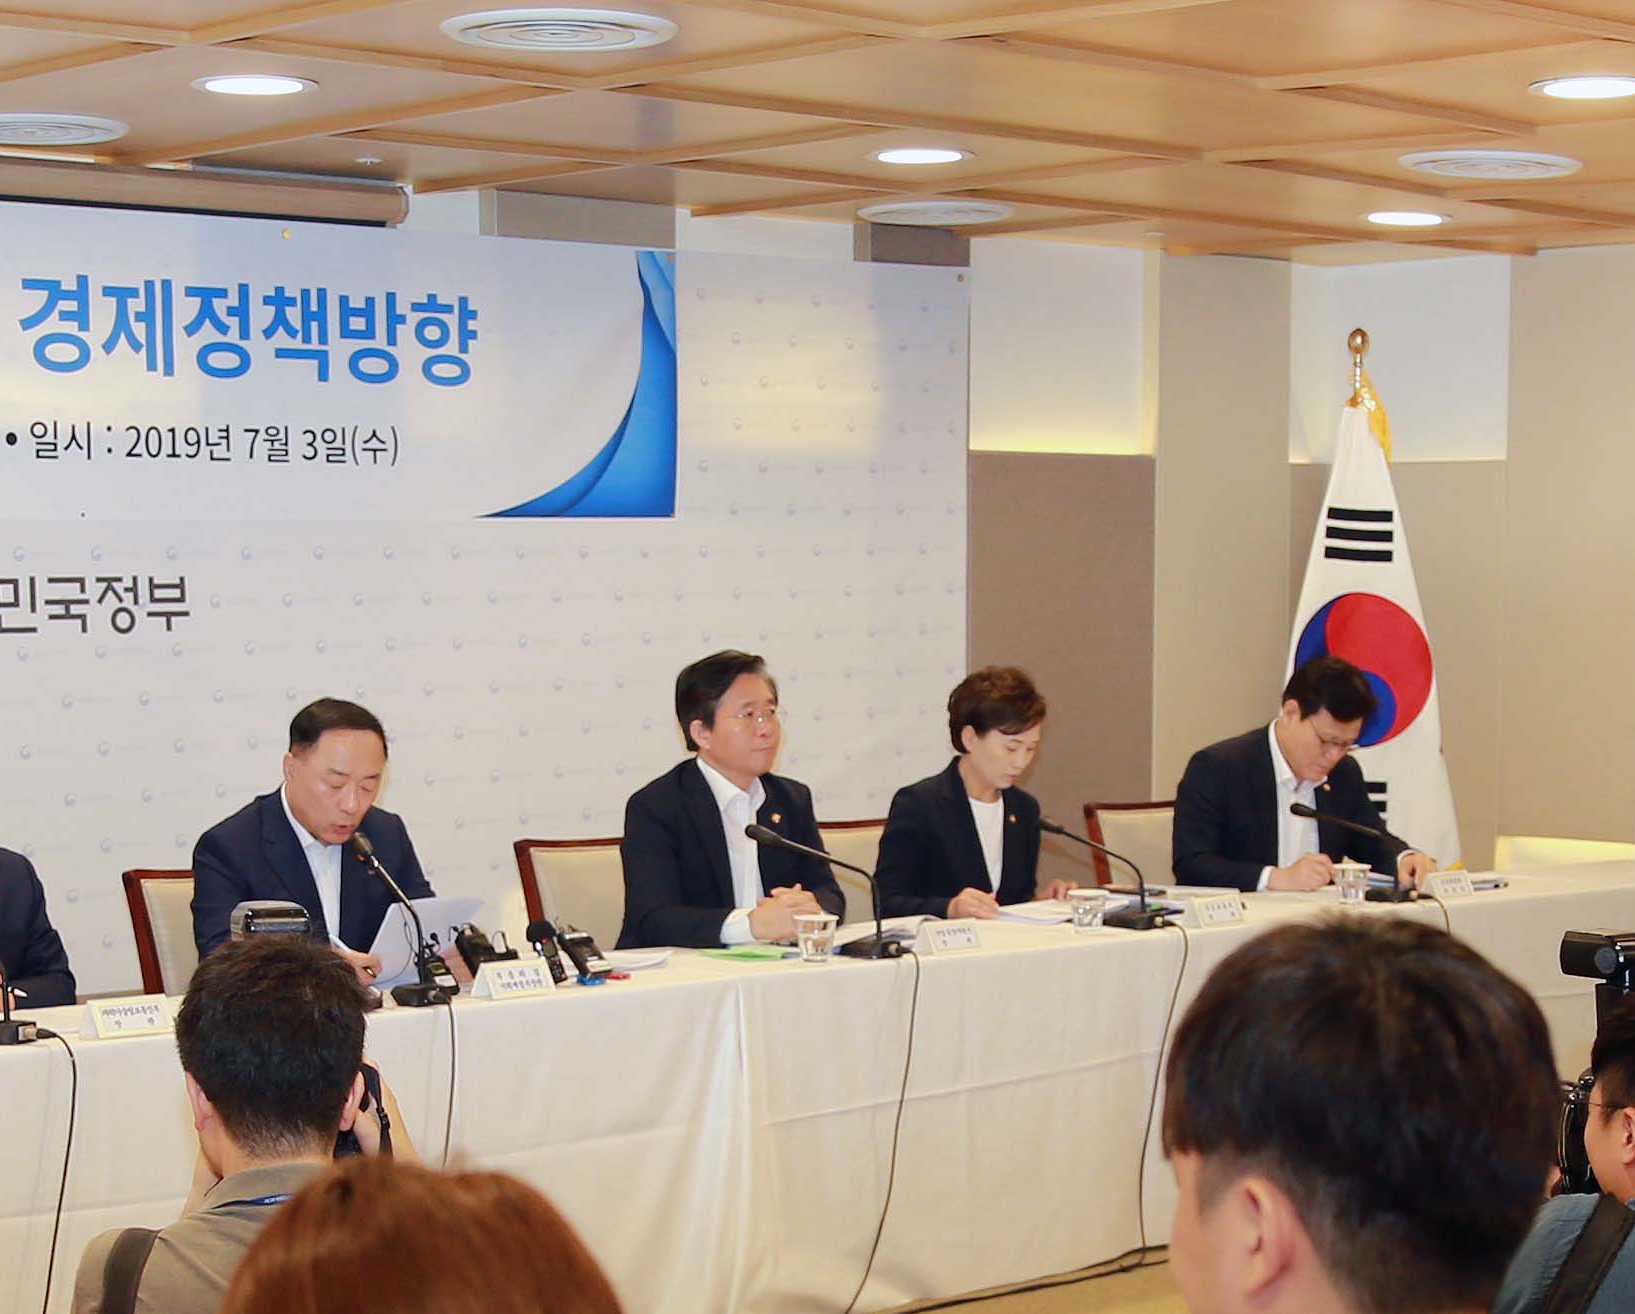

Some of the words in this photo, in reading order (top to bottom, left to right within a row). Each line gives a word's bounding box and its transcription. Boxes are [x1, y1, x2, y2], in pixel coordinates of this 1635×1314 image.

[20, 274, 478, 386] 경제정책방향
[30, 421, 92, 461] 일시
[125, 425, 232, 462] 2019년
[244, 426, 290, 463] 7월
[302, 426, 400, 466] 3일(수)
